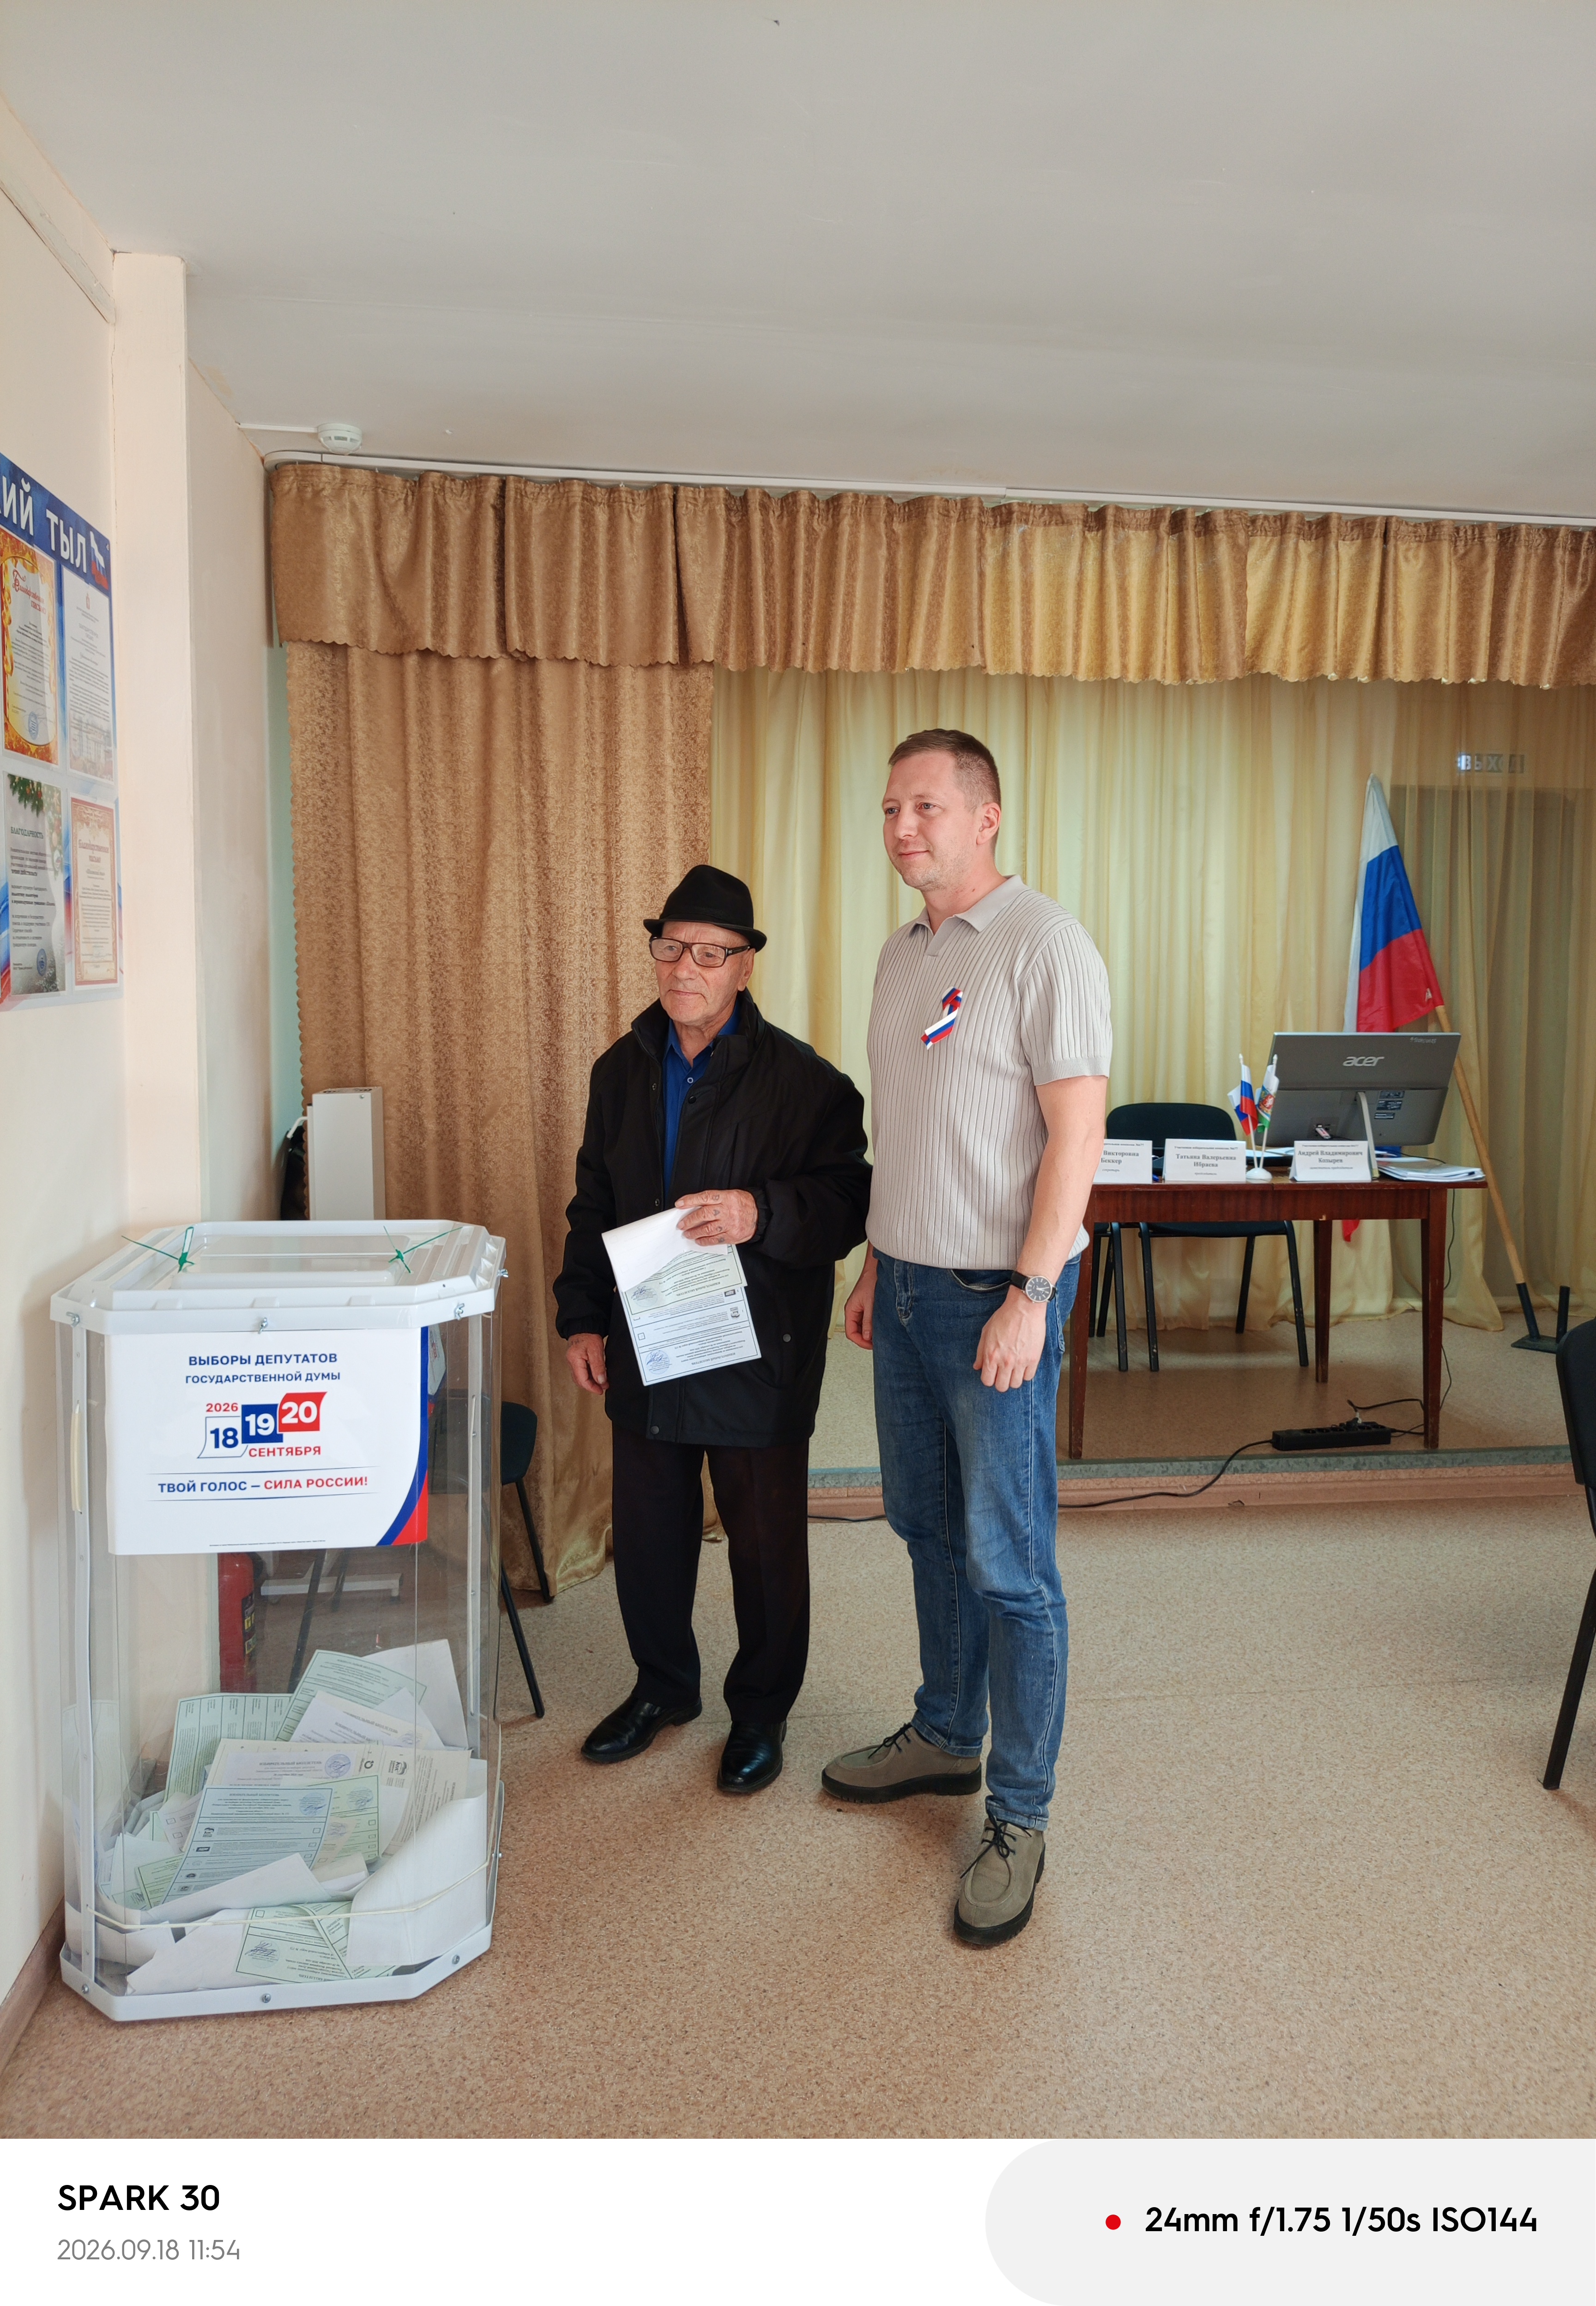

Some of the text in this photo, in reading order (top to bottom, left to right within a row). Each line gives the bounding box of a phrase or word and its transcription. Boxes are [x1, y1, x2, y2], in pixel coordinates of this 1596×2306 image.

[0, 476, 87, 574] ИЙ ТЫЛ
[11, 826, 43, 839] БЛАГОДАРНОСТЬ
[1343, 1056, 1384, 1066] acer
[189, 1353, 338, 1366] ВЫБОРЫ ДЕПУТАТОВ
[186, 1371, 340, 1385] ГОСУДАРСТВЕННОЙ ДУМЫ
[206, 1402, 239, 1412] 2026
[281, 1402, 317, 1424] 20
[245, 1414, 275, 1436] 19
[210, 1427, 239, 1448] 18
[248, 1446, 321, 1457] СЕНТЯБРЯ
[158, 1481, 196, 1493] ТВОЙ
[200, 1481, 247, 1492] ГОЛОС
[264, 1479, 302, 1490] СИЛА
[306, 1477, 368, 1488] РОССИИ!
